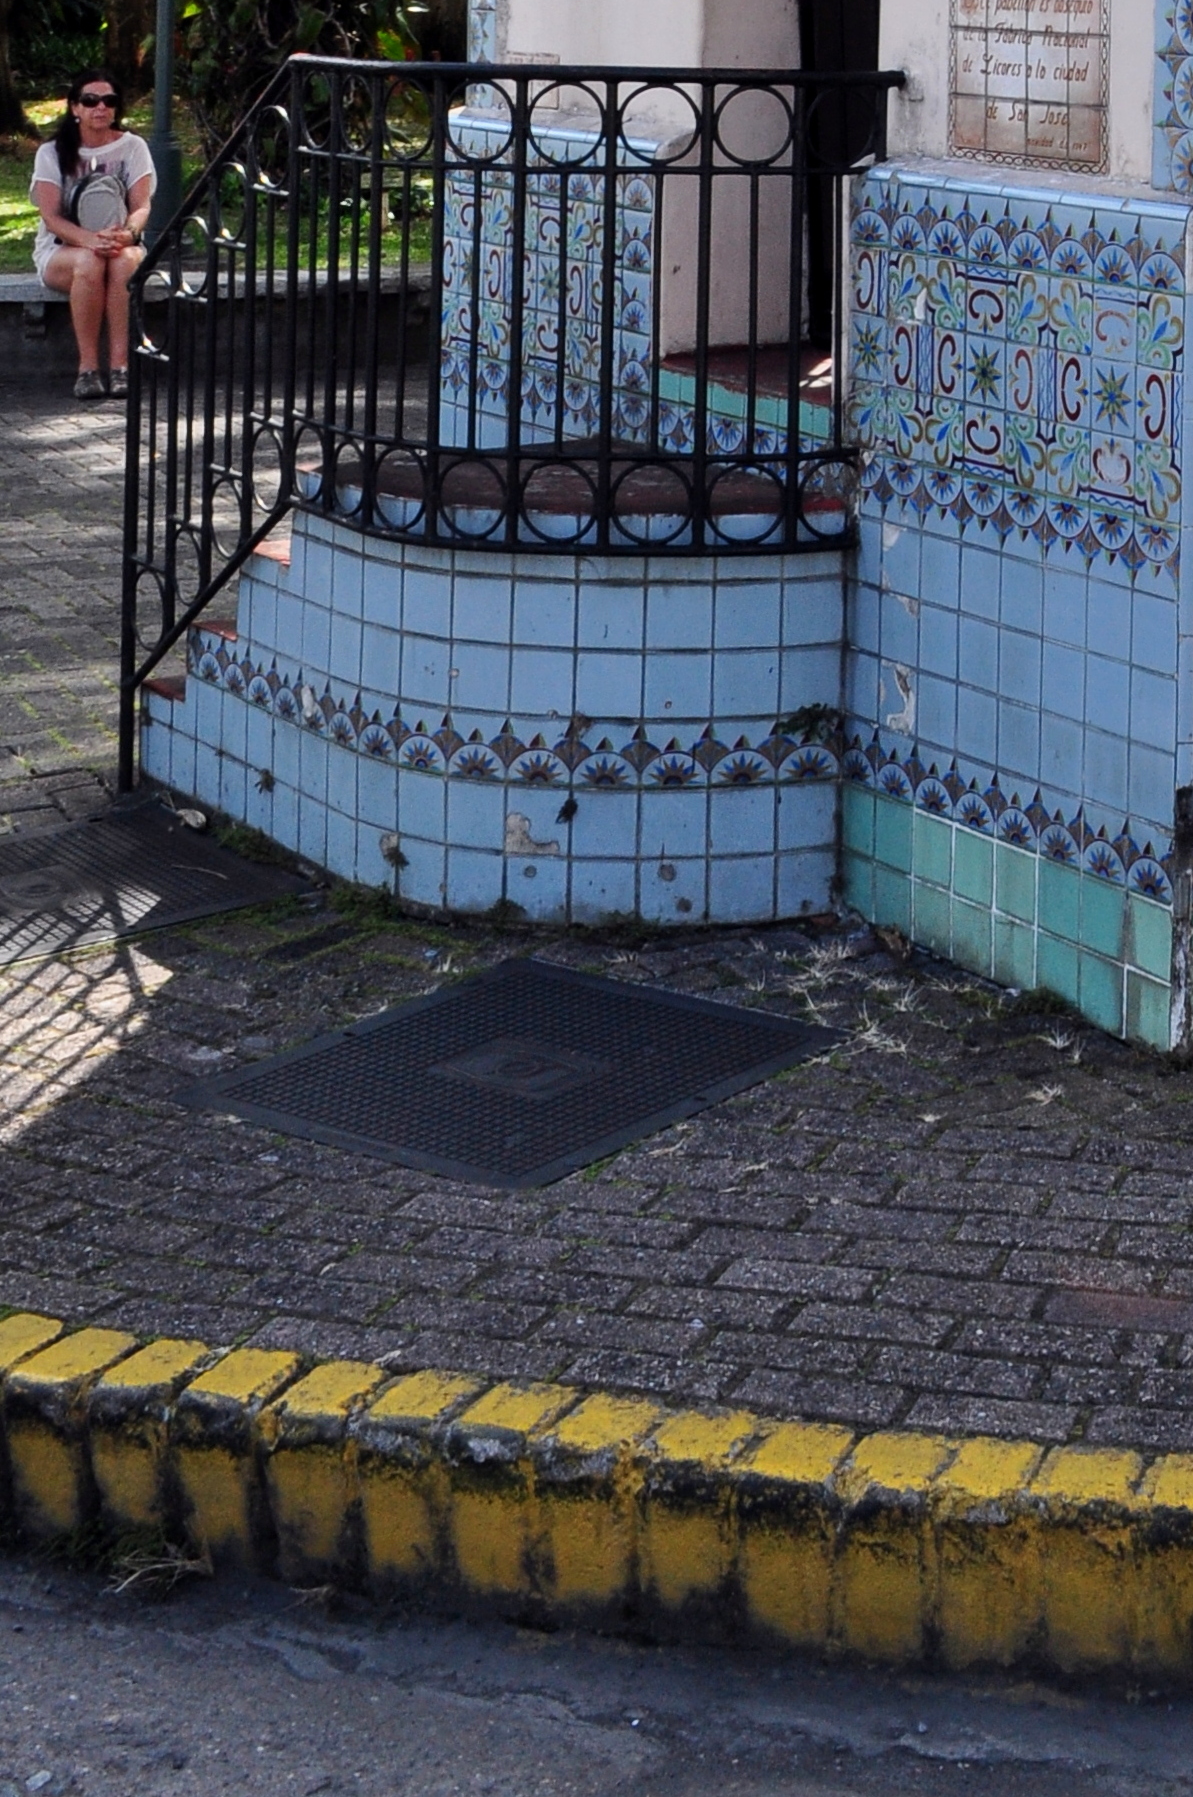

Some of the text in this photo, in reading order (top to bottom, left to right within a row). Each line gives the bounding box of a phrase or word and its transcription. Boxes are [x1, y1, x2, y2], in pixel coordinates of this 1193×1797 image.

[963, 22, 973, 41] de
[977, 22, 987, 42] la
[1042, 24, 1090, 48] Nacional
[962, 53, 1089, 82] de Licores a la ciudad
[987, 99, 998, 120] de
[1008, 100, 1028, 121] San
